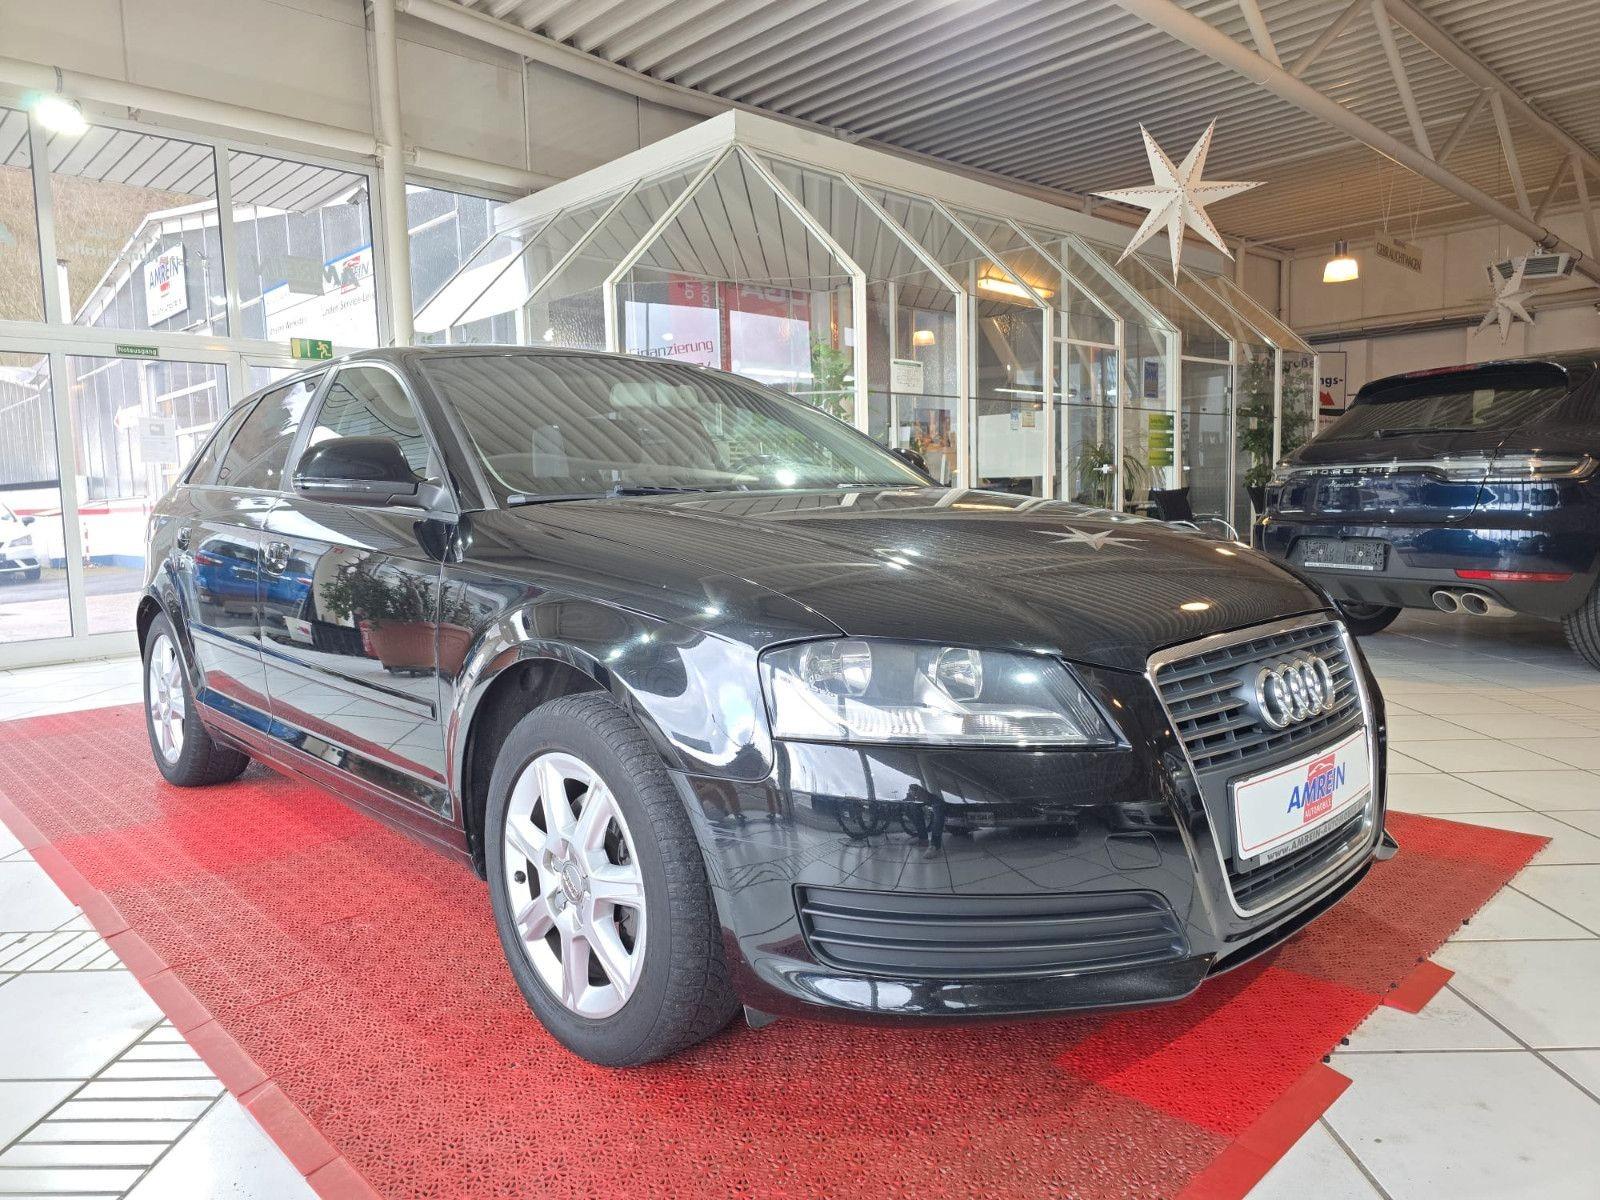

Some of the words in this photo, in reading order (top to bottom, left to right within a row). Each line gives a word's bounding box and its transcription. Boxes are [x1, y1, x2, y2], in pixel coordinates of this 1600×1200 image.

[149, 256, 179, 290] AMREIN
[117, 345, 157, 356] Notausgang
[1287, 762, 1346, 813] AMREIN
